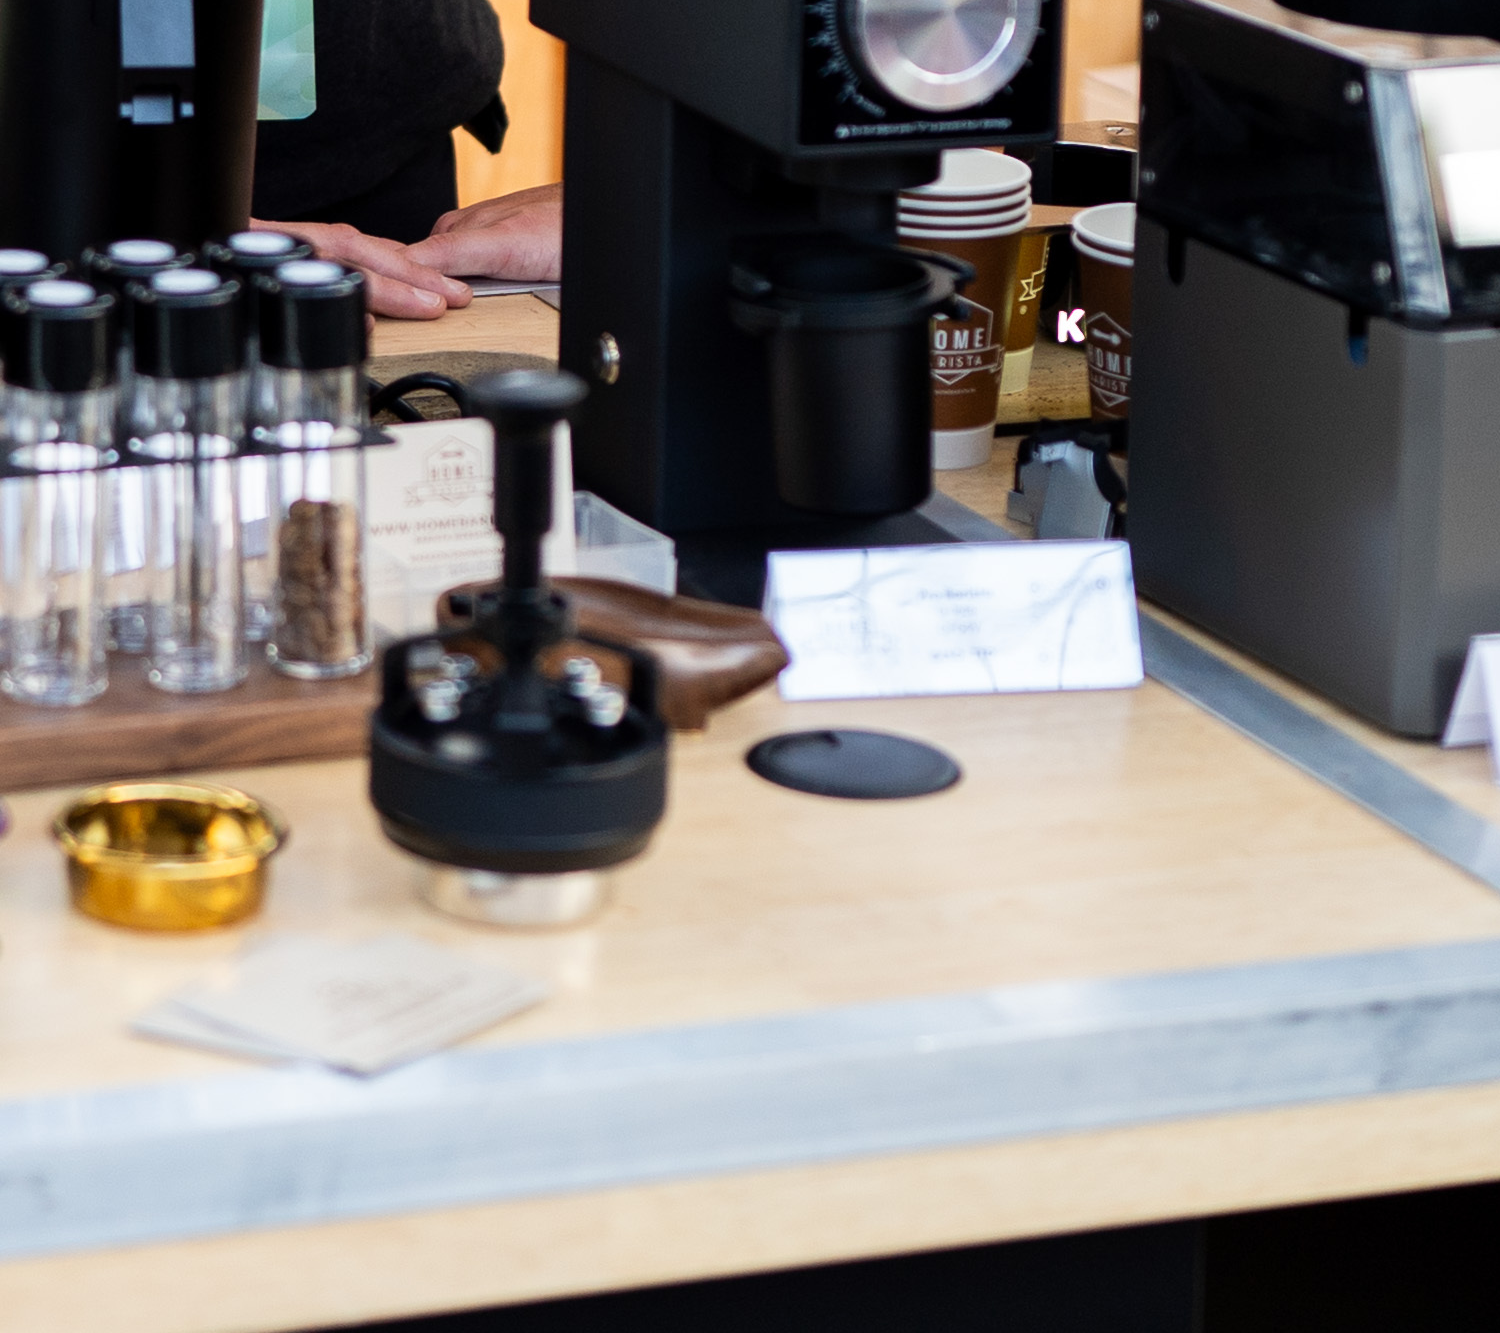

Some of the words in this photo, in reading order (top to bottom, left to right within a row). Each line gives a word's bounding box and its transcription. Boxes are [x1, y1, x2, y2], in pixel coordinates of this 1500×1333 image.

[1057, 308, 1086, 343] K
[934, 327, 986, 350] OME
[937, 354, 983, 369] RISTA
